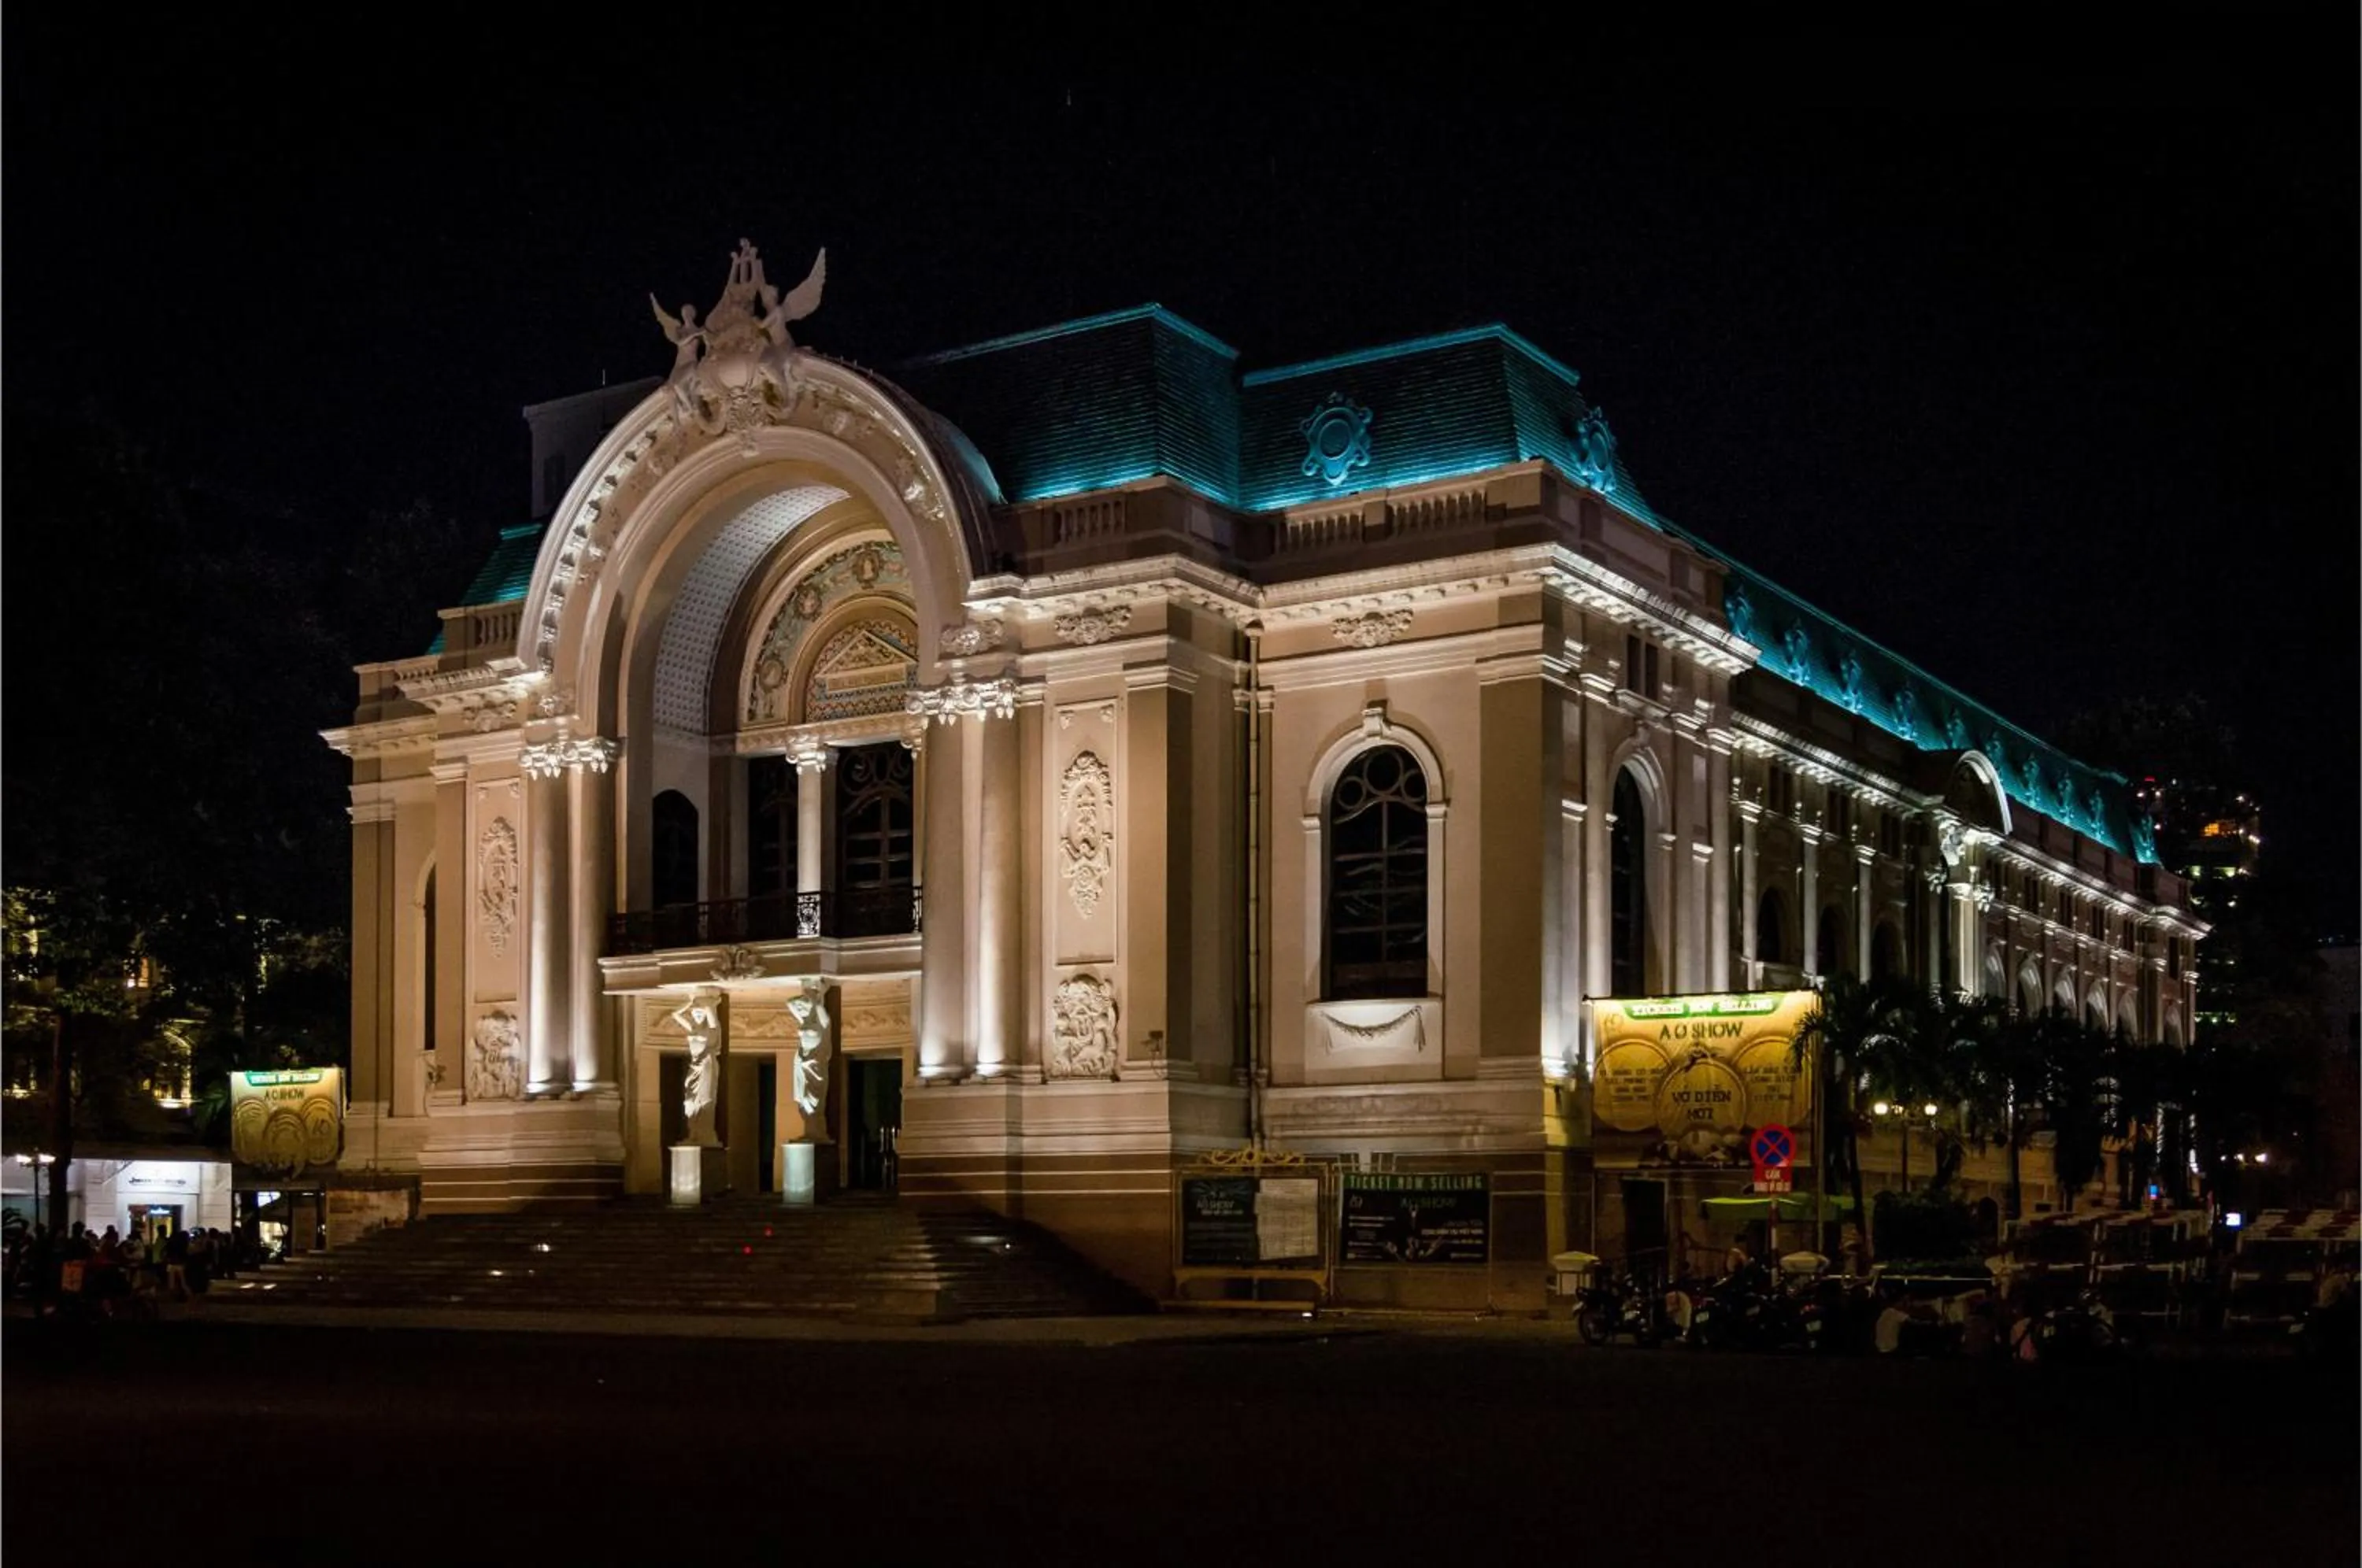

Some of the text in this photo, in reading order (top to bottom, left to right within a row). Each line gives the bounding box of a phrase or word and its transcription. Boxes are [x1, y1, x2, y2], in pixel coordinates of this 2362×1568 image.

[1691, 1021, 1743, 1037] SHOW
[1349, 1175, 1390, 1191] TICKET
[1431, 1175, 1482, 1191] SELLING
